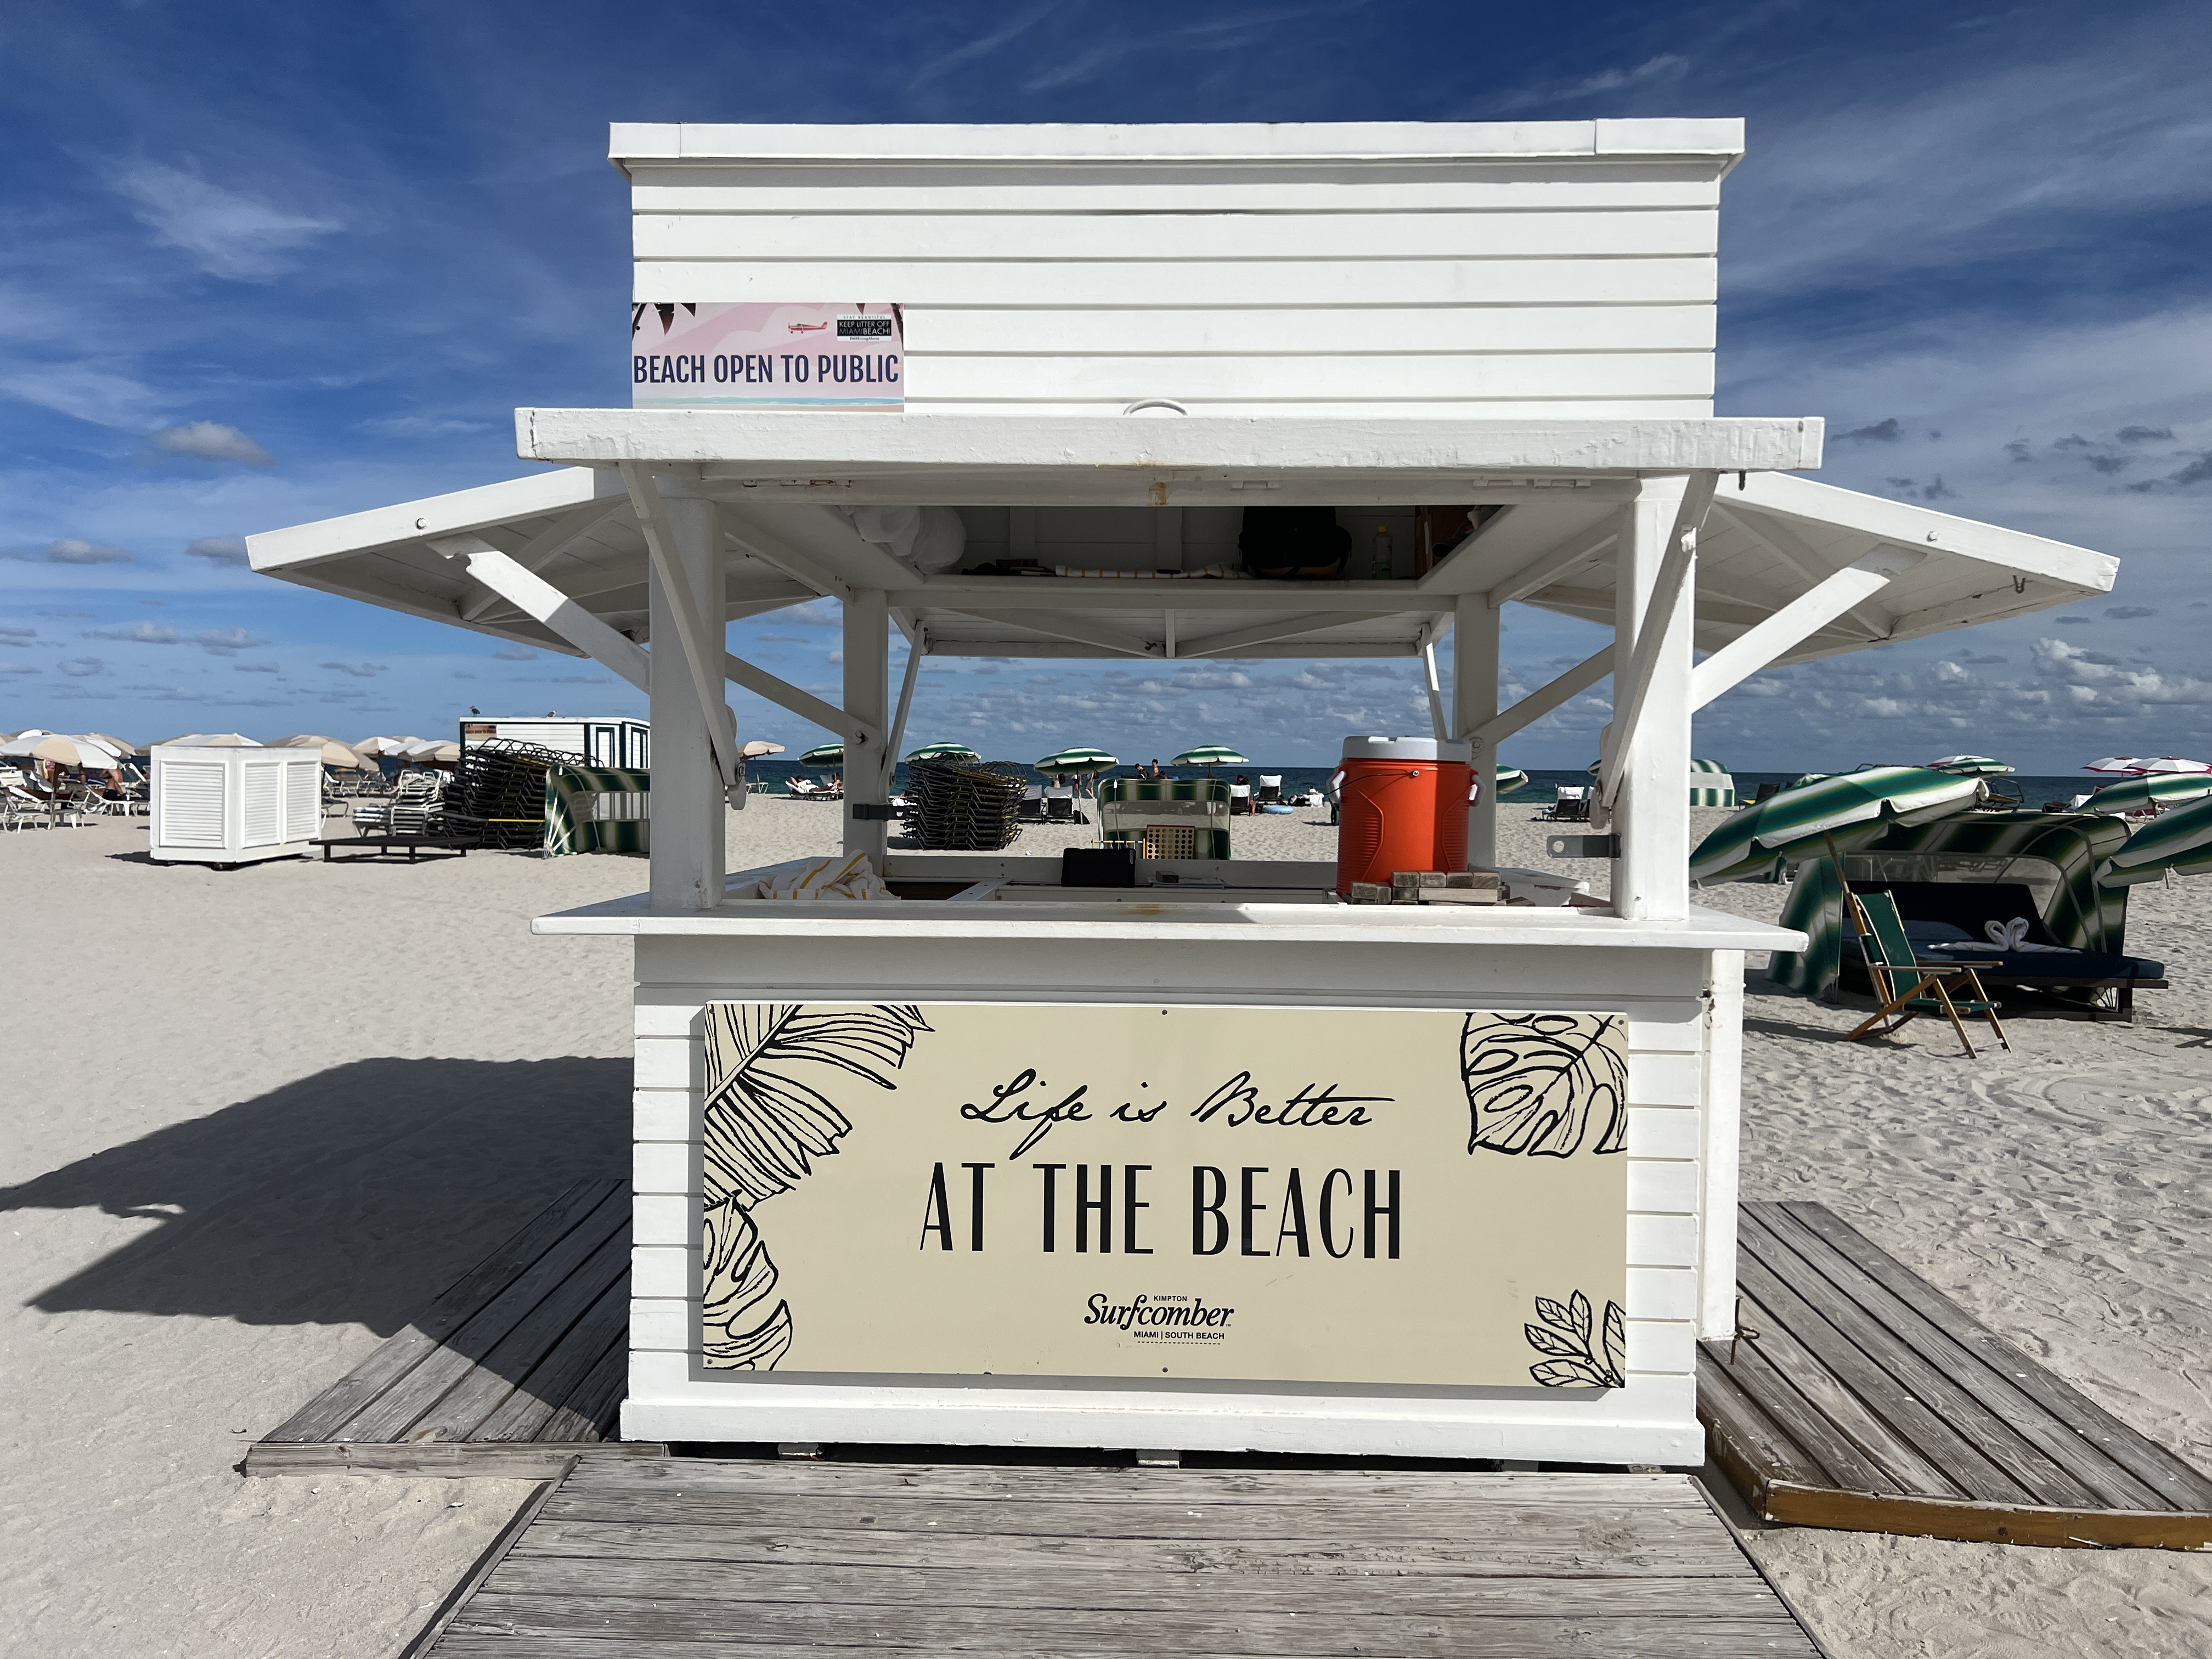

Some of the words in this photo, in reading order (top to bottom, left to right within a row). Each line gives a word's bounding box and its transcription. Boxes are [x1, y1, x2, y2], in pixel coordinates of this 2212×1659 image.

[634, 355, 705, 383] BEACH
[714, 354, 772, 383] OPEN
[780, 354, 809, 383] TO
[818, 354, 899, 383] PUBLIC
[960, 1068, 1093, 1161] Life
[1109, 1081, 1167, 1122] is
[1190, 1070, 1396, 1127] Better
[919, 1162, 995, 1251] AT
[1032, 1163, 1154, 1254] THE
[1192, 1166, 1400, 1260] BEACH
[1084, 1293, 1234, 1330] Surfcomber
